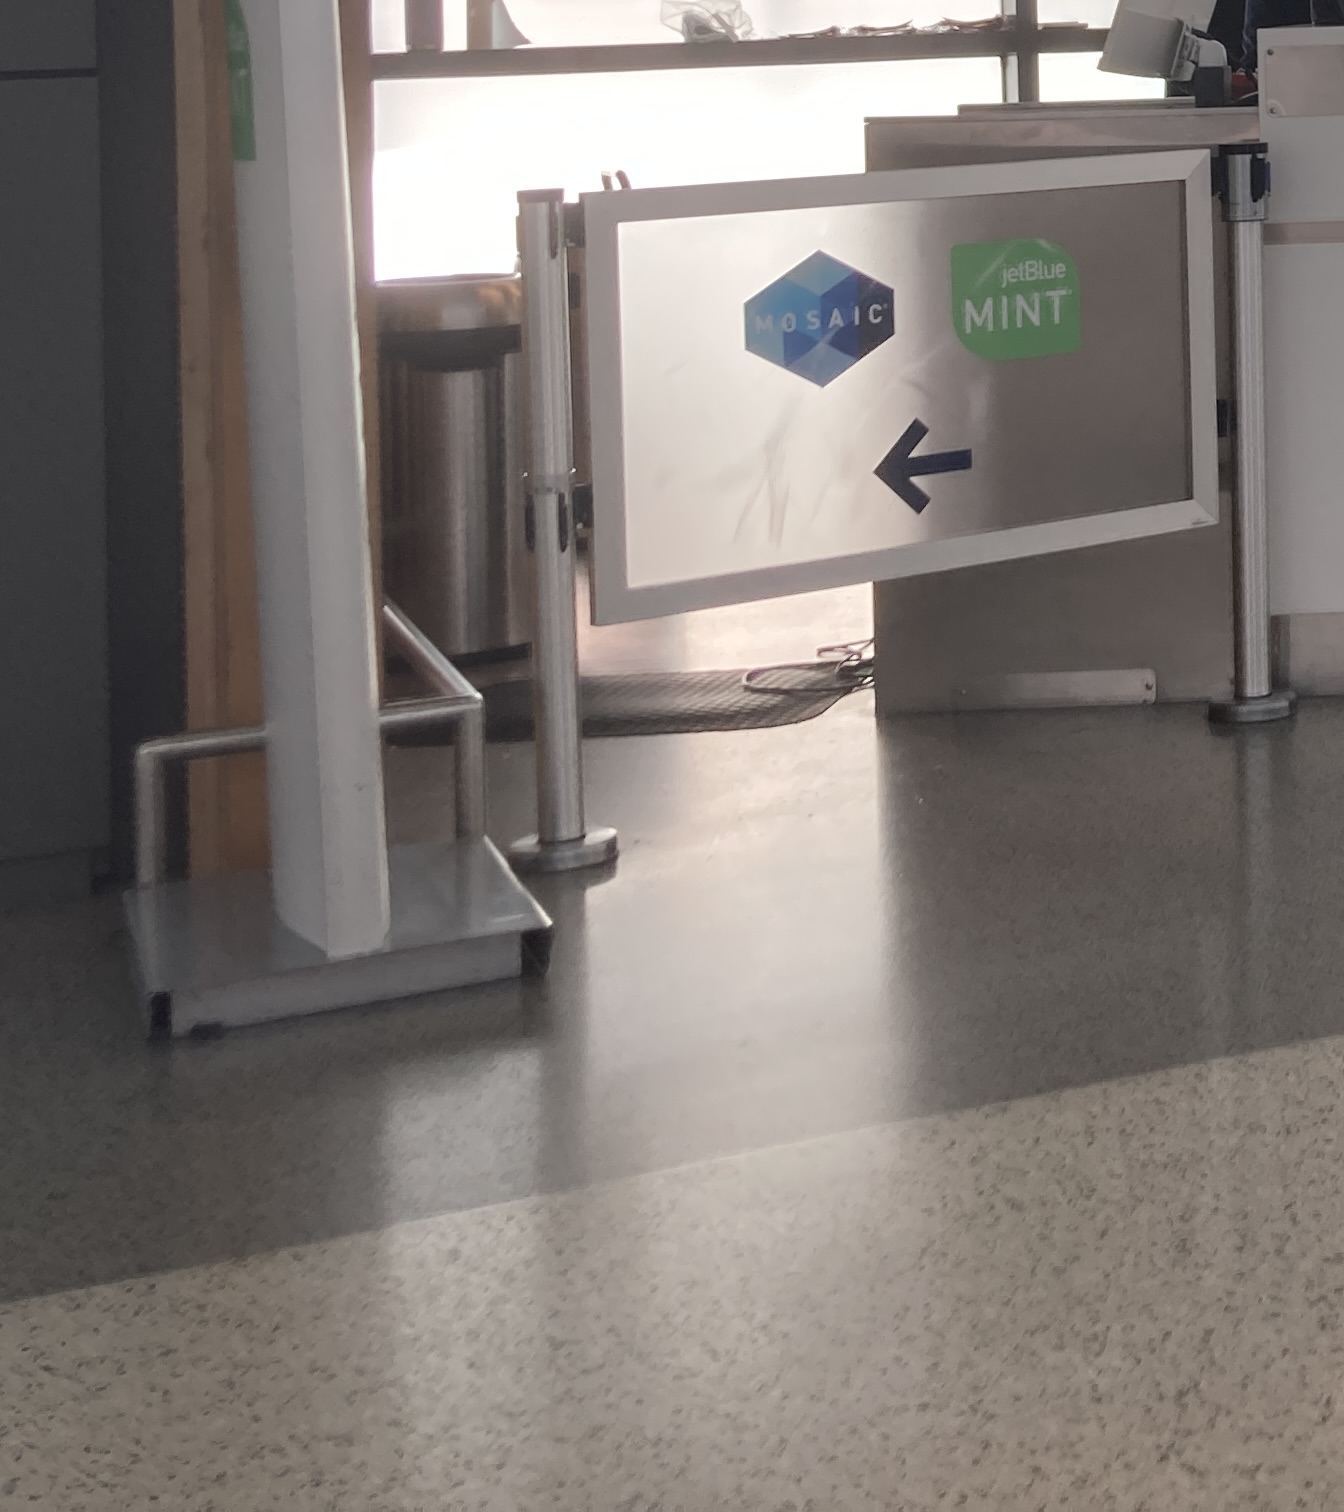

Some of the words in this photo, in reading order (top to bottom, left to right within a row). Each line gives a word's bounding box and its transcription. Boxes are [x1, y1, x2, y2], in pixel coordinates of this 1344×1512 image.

[1001, 259, 1067, 288] jetBlue
[755, 303, 884, 334] MOSAIC
[964, 289, 1068, 334] MINT
